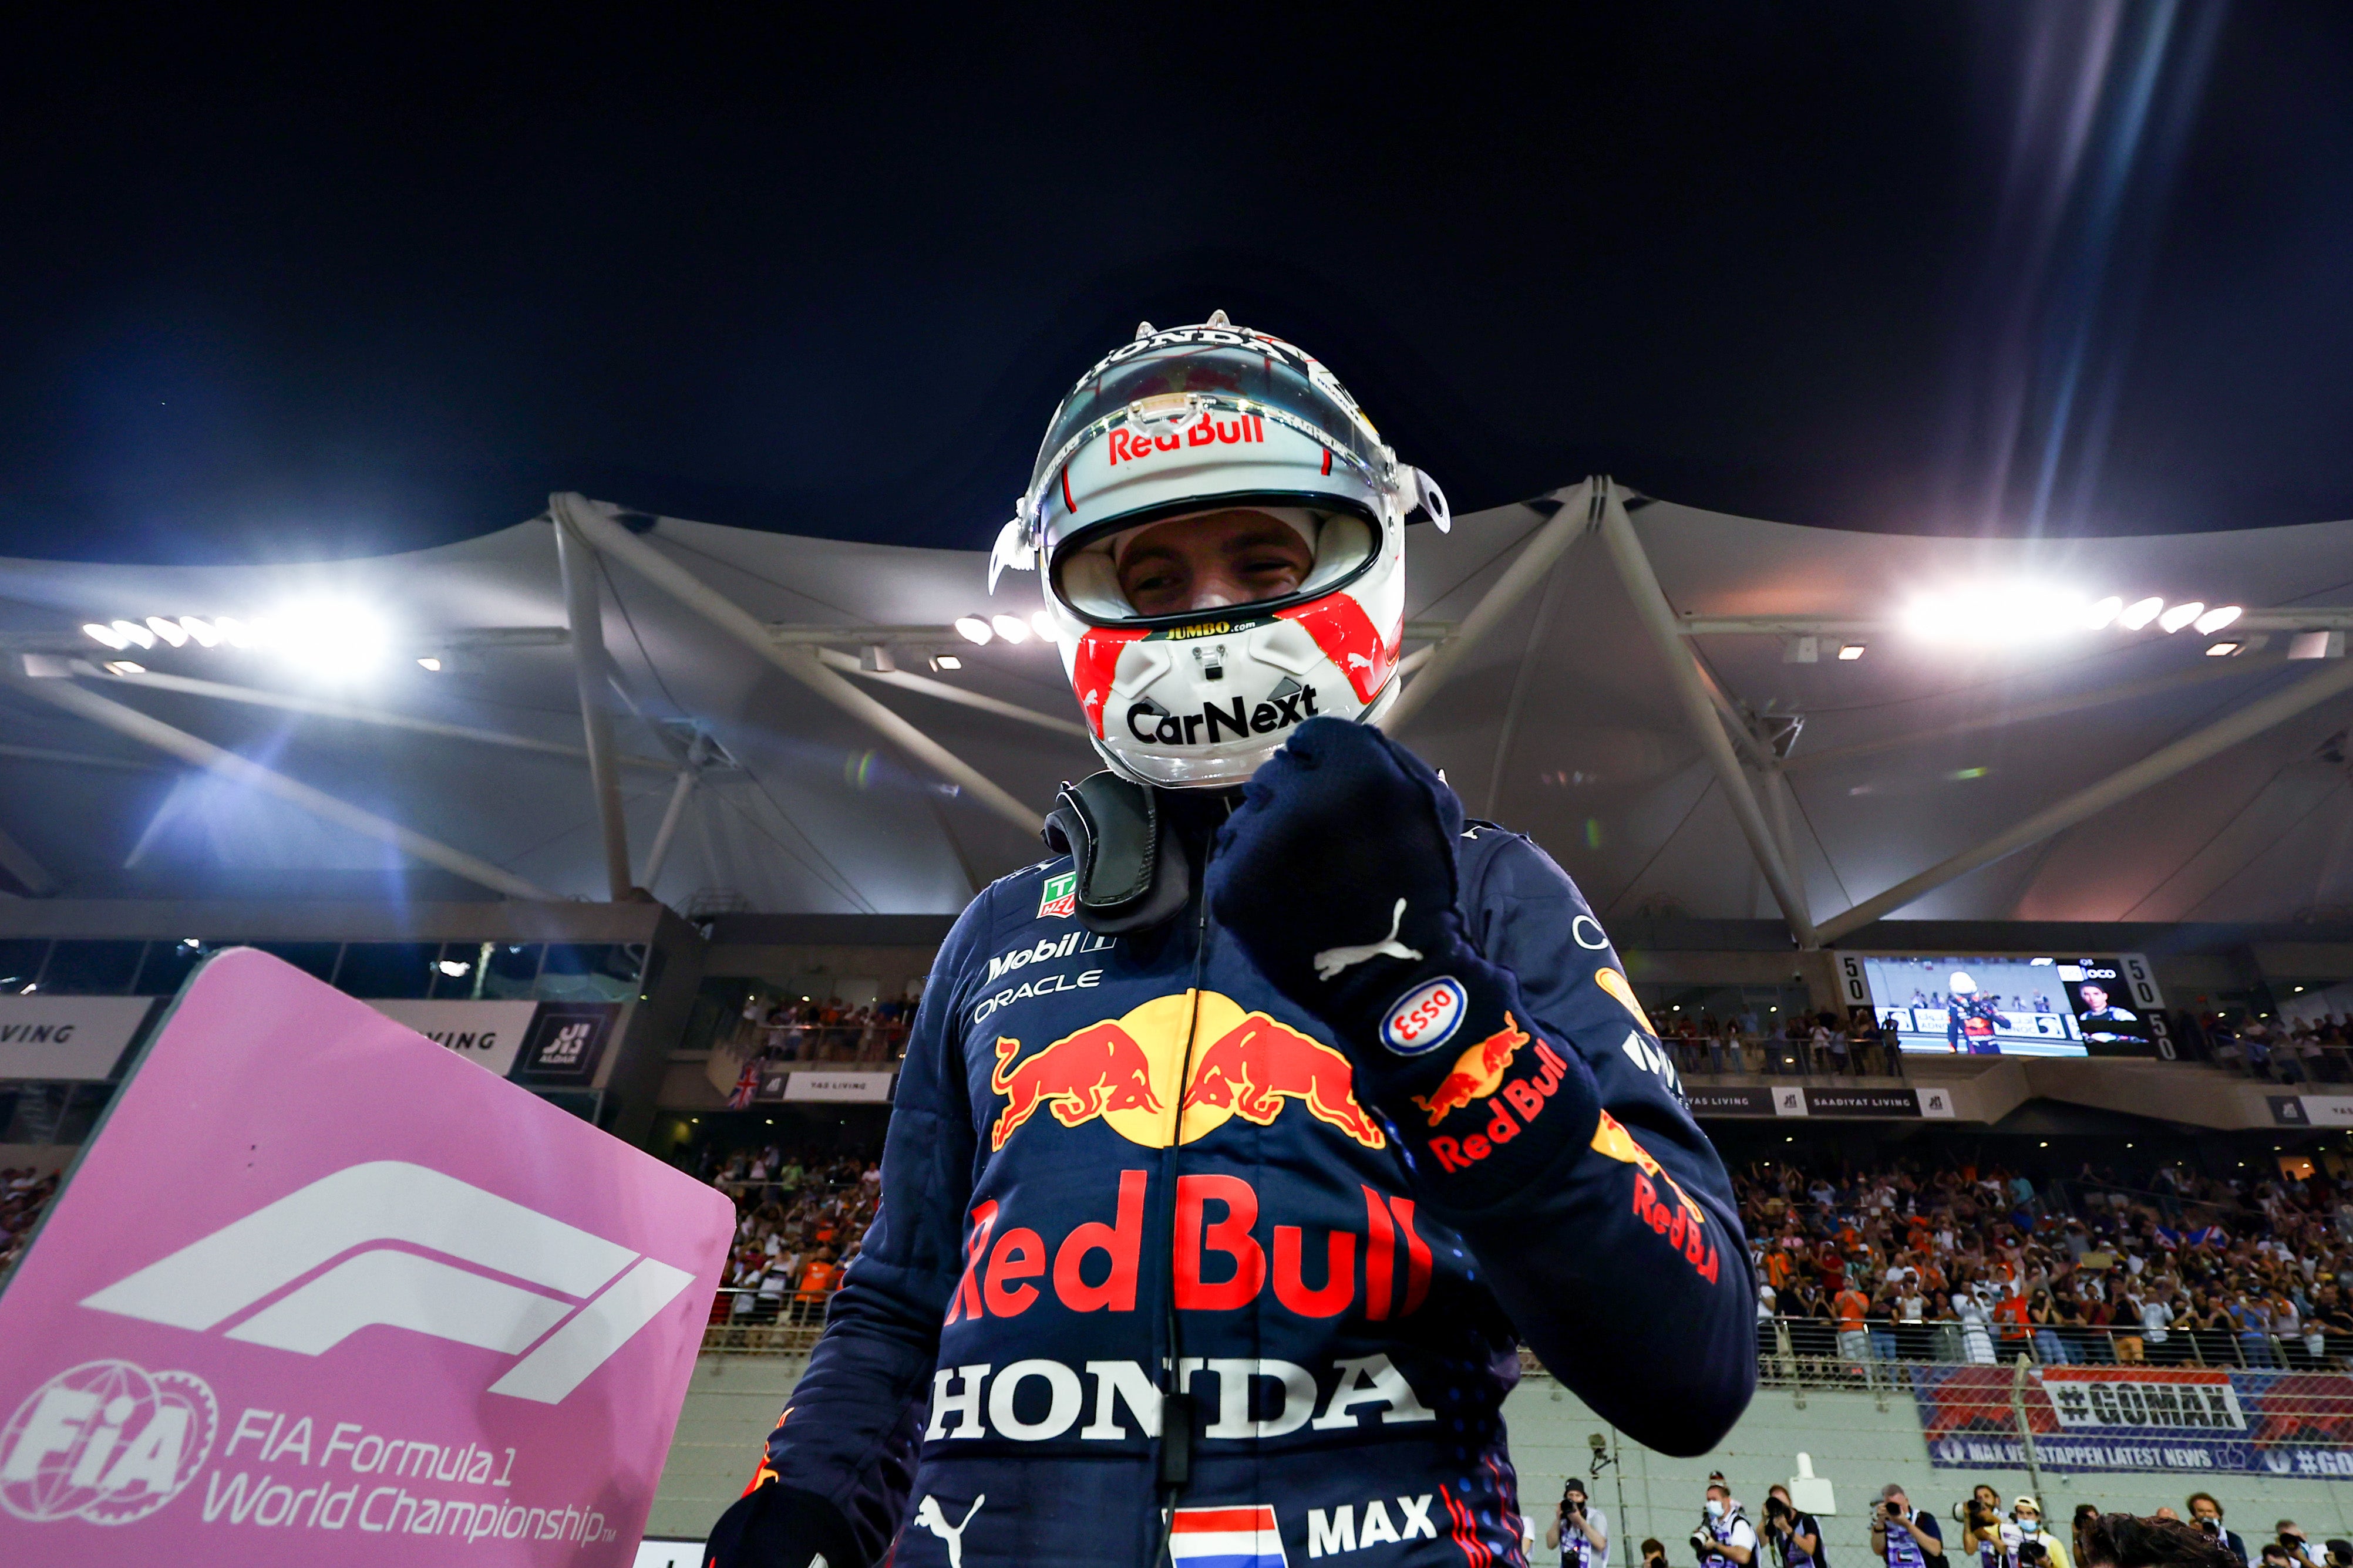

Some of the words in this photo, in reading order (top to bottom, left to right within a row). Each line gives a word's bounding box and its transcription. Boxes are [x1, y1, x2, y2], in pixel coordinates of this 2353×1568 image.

[1187, 412, 1264, 447] Bull
[1127, 683, 1319, 746] CarNext
[985, 931, 1081, 986] Mobil
[974, 970, 1104, 1024] ORACLE
[1428, 1097, 1521, 1173] Red
[1502, 1037, 1567, 1122] Bull
[1688, 1097, 1708, 1105] YAS
[1711, 1097, 1749, 1105] LIVING
[1813, 1098, 1868, 1107] SAADIYAT
[1871, 1098, 1910, 1107] LIVING
[1632, 1172, 1687, 1250] Red
[944, 1169, 1148, 1327] Red
[1174, 1174, 1433, 1321] Bull
[924, 1353, 1436, 1442] HONDA
[224, 1408, 319, 1465] FIA
[321, 1422, 492, 1484] Formula
[2005, 1444, 2106, 1466] VESTAPPEN
[2106, 1446, 2162, 1466] LATEST
[2163, 1448, 2213, 1468] NEWS
[202, 1469, 359, 1531] World
[359, 1485, 605, 1547] Championship
[1307, 1493, 1438, 1559] MAX
